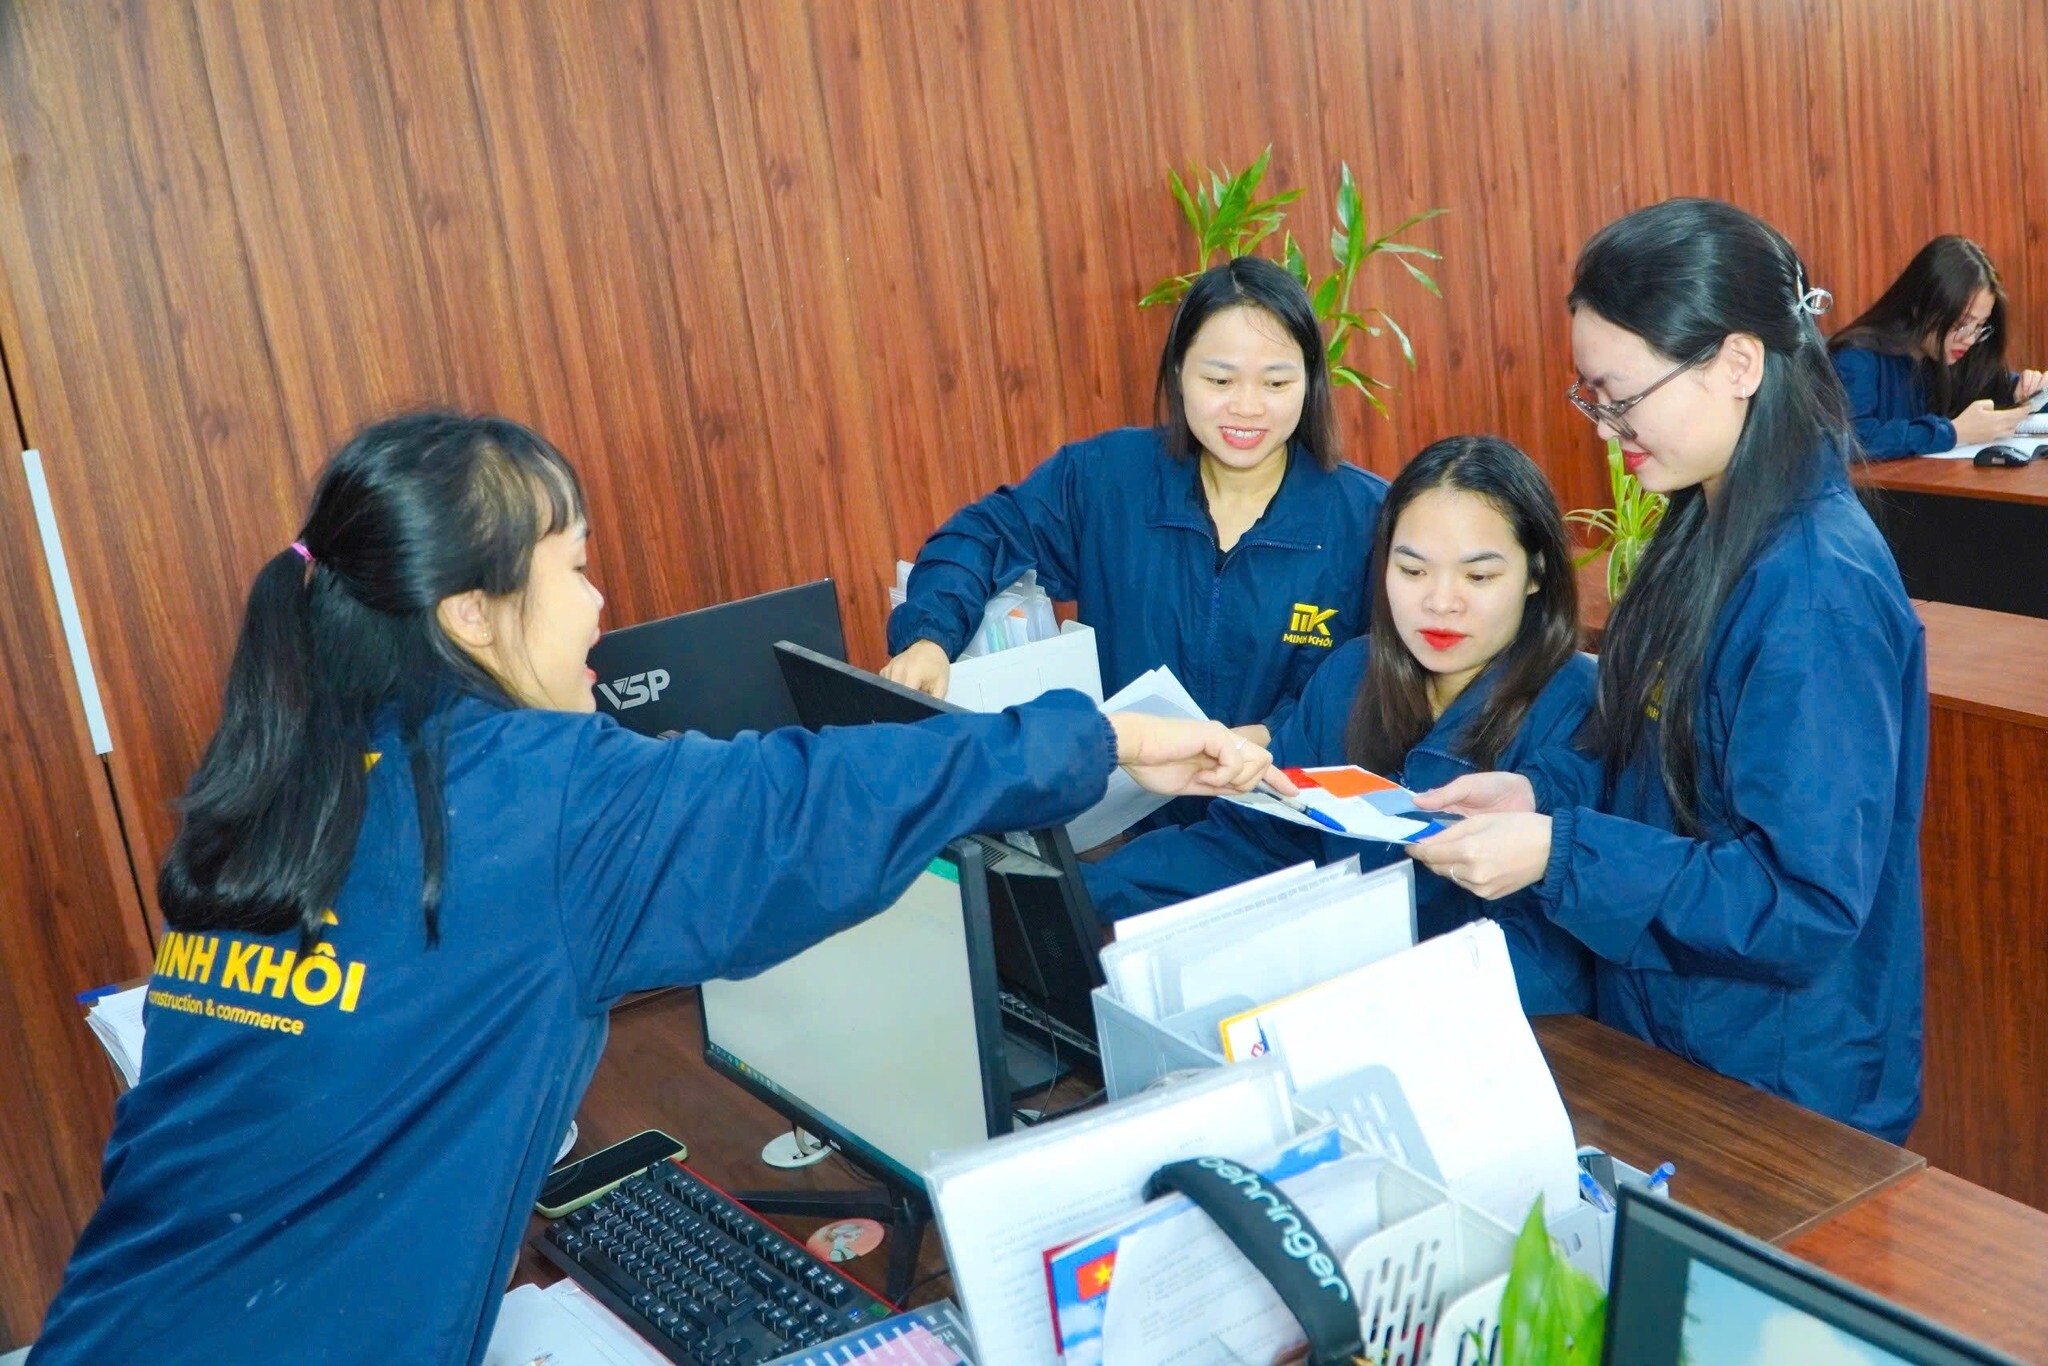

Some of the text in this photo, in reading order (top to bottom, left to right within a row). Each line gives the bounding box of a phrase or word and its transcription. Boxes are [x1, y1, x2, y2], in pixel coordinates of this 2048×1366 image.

[1283, 633, 1307, 644] MINH
[597, 669, 671, 710] VSP
[221, 940, 366, 1012] KHÔI
[205, 998, 215, 1017] &
[216, 1002, 304, 1035] commerce
